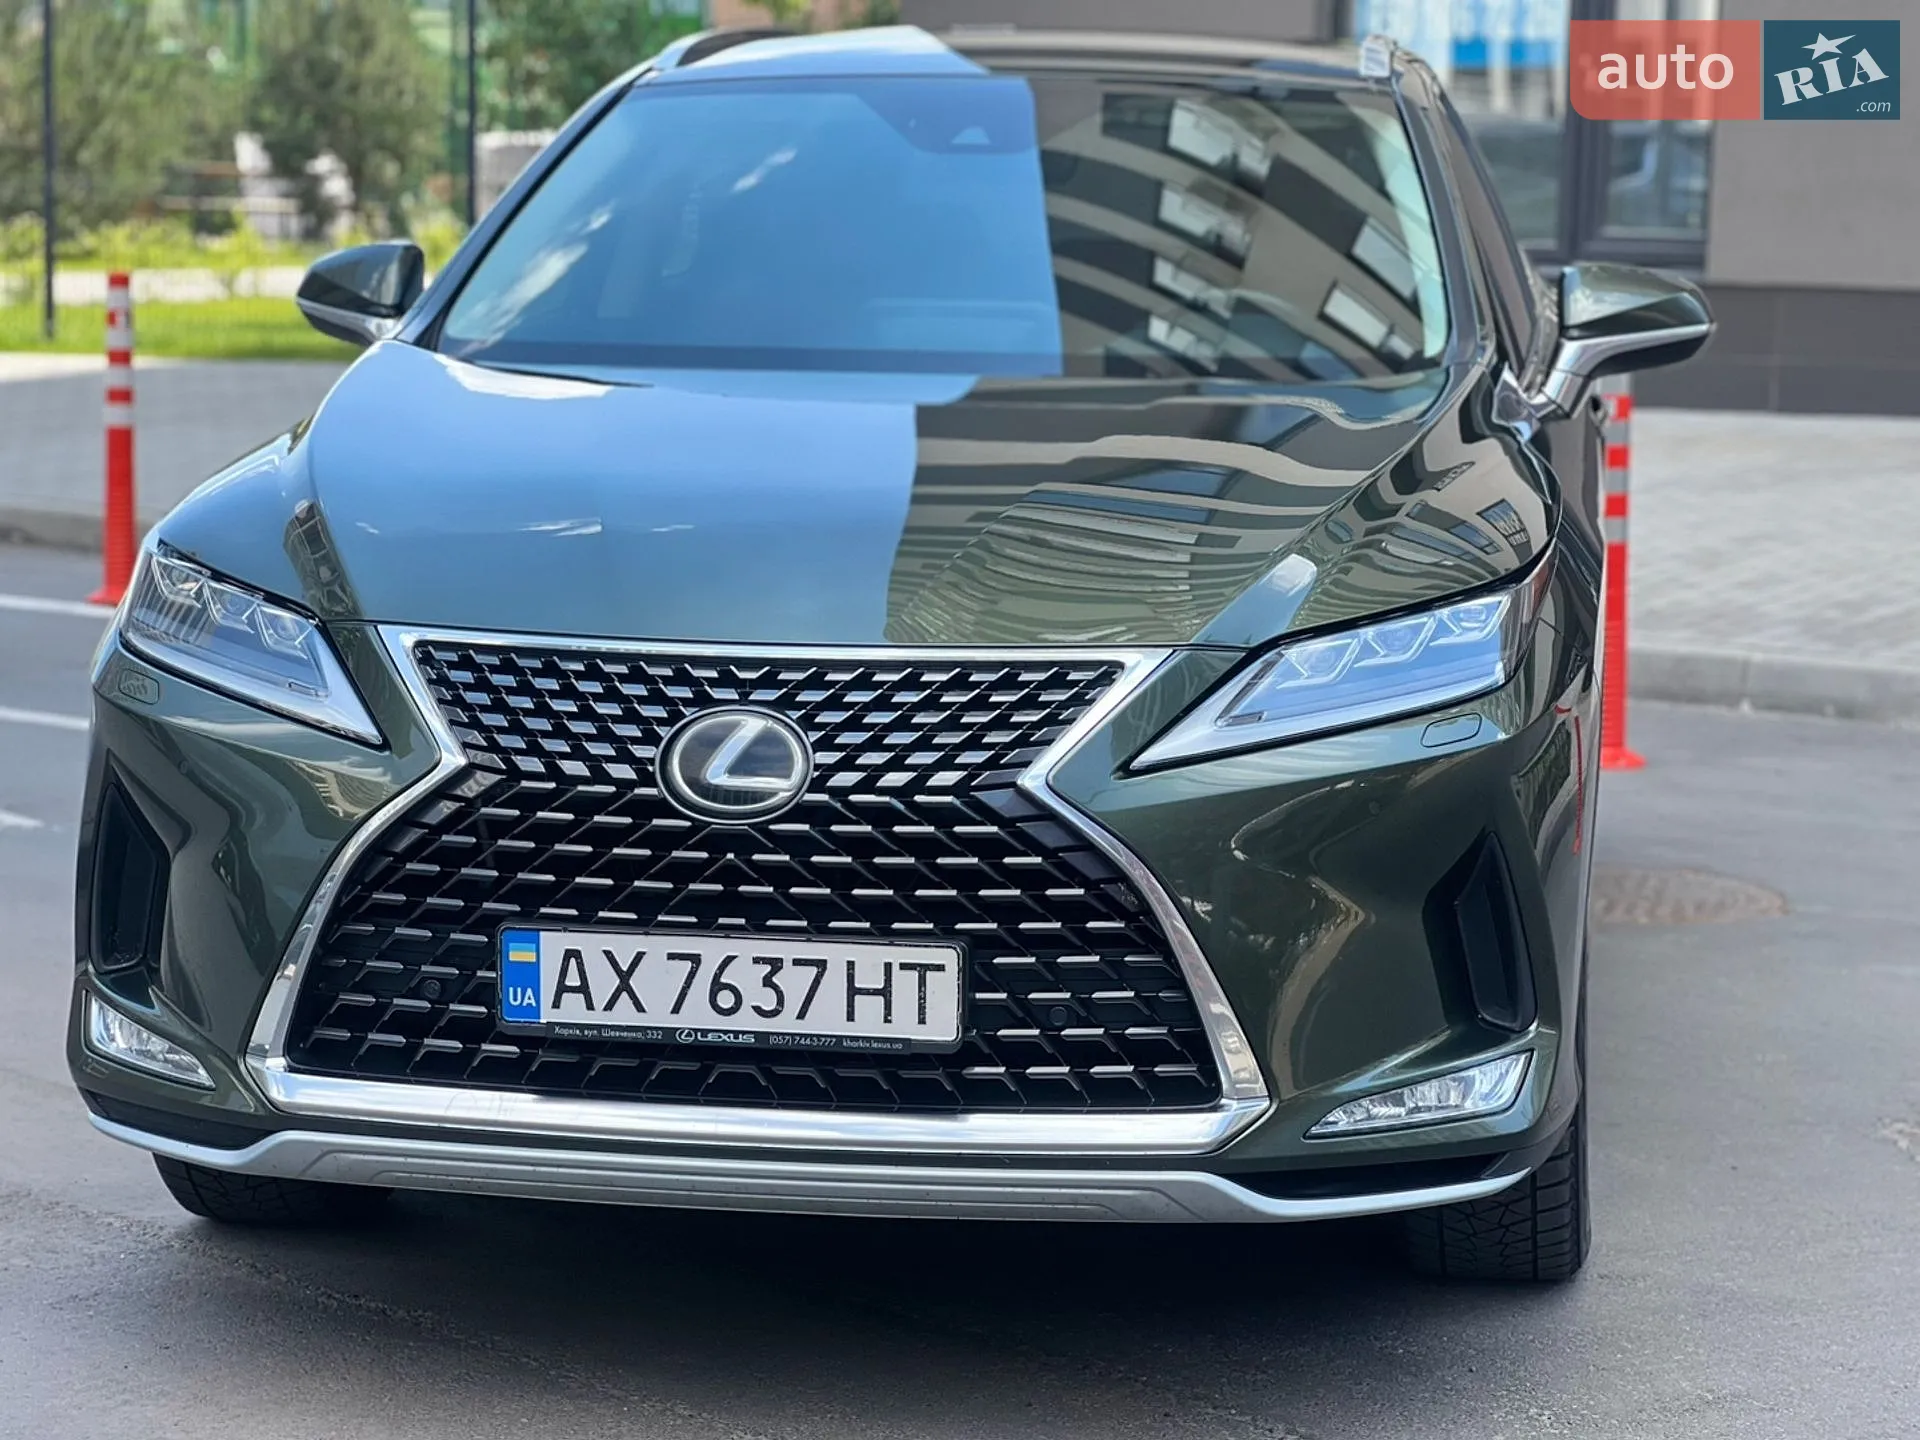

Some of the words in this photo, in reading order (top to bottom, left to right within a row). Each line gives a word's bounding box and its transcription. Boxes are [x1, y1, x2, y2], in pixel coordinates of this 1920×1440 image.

[550, 948, 648, 1014] AX
[666, 952, 828, 1020] 7637
[846, 960, 946, 1025] HT
[508, 986, 537, 1007] UA
[646, 1030, 663, 1040] 332
[697, 1031, 755, 1043] LEXUS
[769, 1034, 792, 1046] (057)
